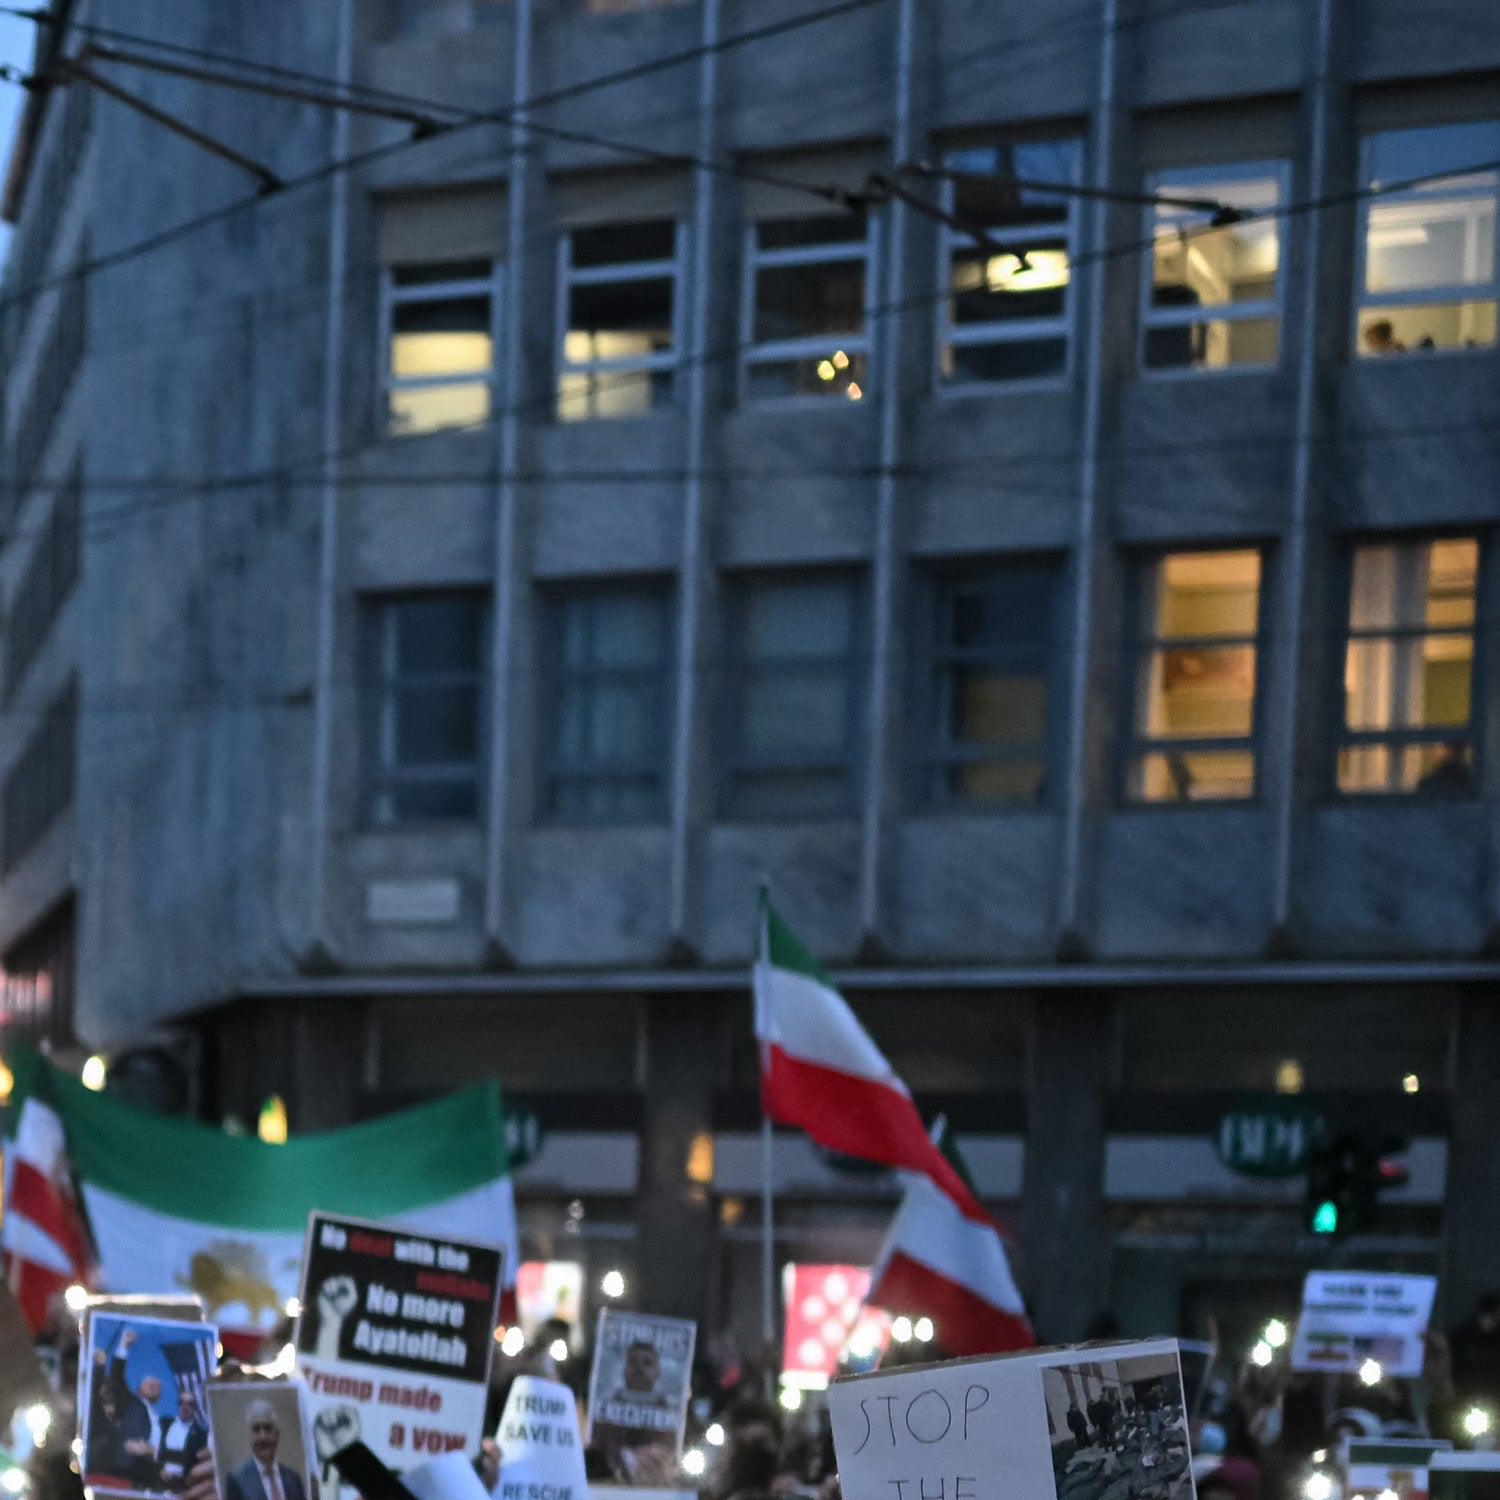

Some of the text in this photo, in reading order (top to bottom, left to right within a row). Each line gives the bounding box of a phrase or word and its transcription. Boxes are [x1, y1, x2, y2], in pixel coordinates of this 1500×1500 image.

[366, 1282, 466, 1329] No more
[354, 1319, 468, 1367] Ayatollah
[379, 1385, 442, 1413] made
[854, 1383, 990, 1456] STOP
[504, 1424, 550, 1445] SAVE
